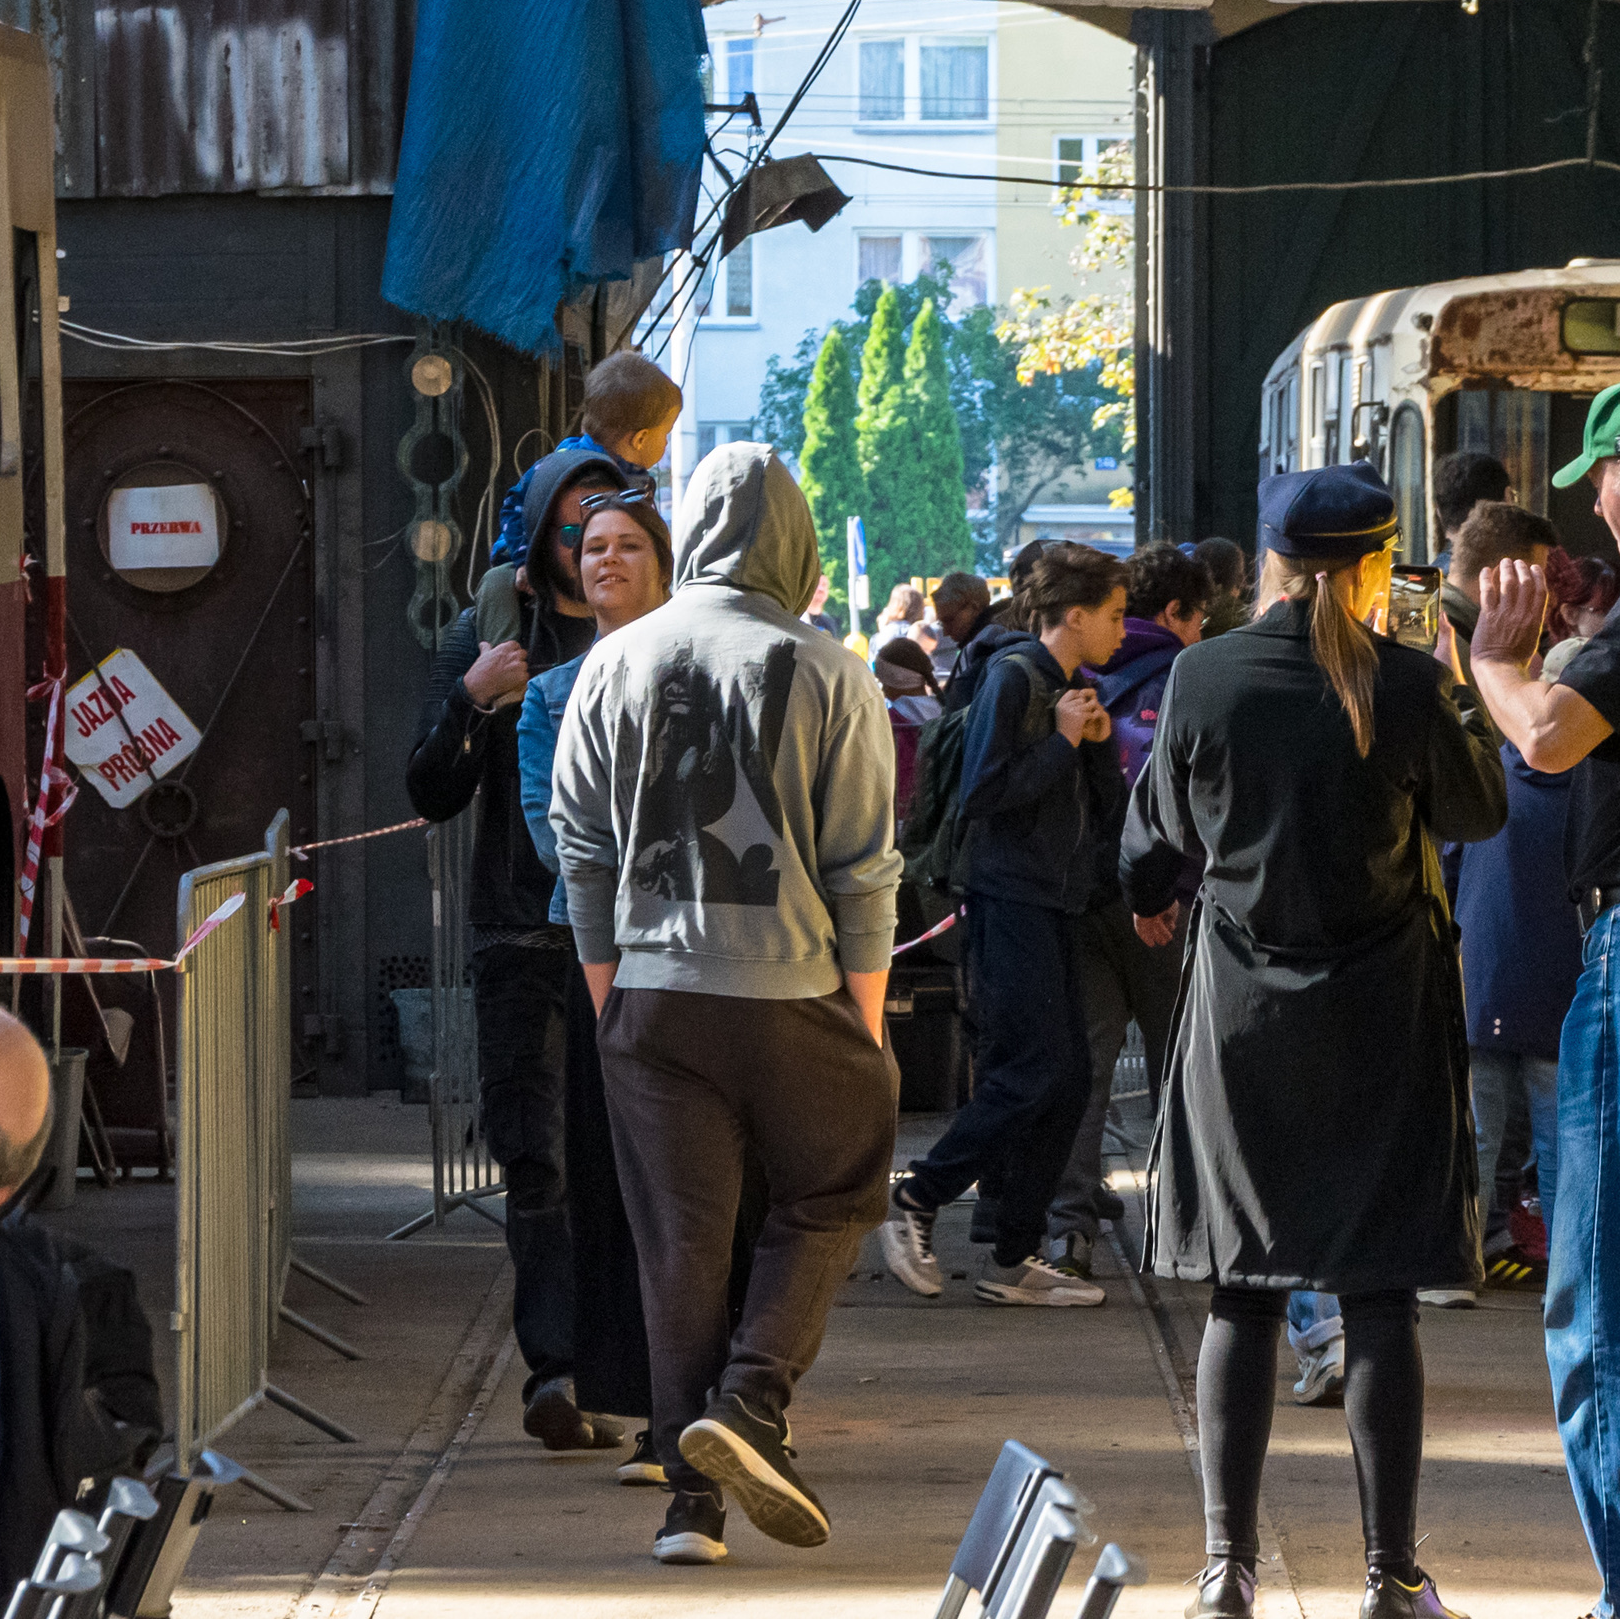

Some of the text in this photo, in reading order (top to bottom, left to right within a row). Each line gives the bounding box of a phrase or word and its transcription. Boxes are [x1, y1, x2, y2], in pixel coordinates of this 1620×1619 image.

[130, 521, 202, 535] PRZERWA
[70, 674, 137, 738] JAZDA
[98, 717, 182, 792] PRÓBNA
